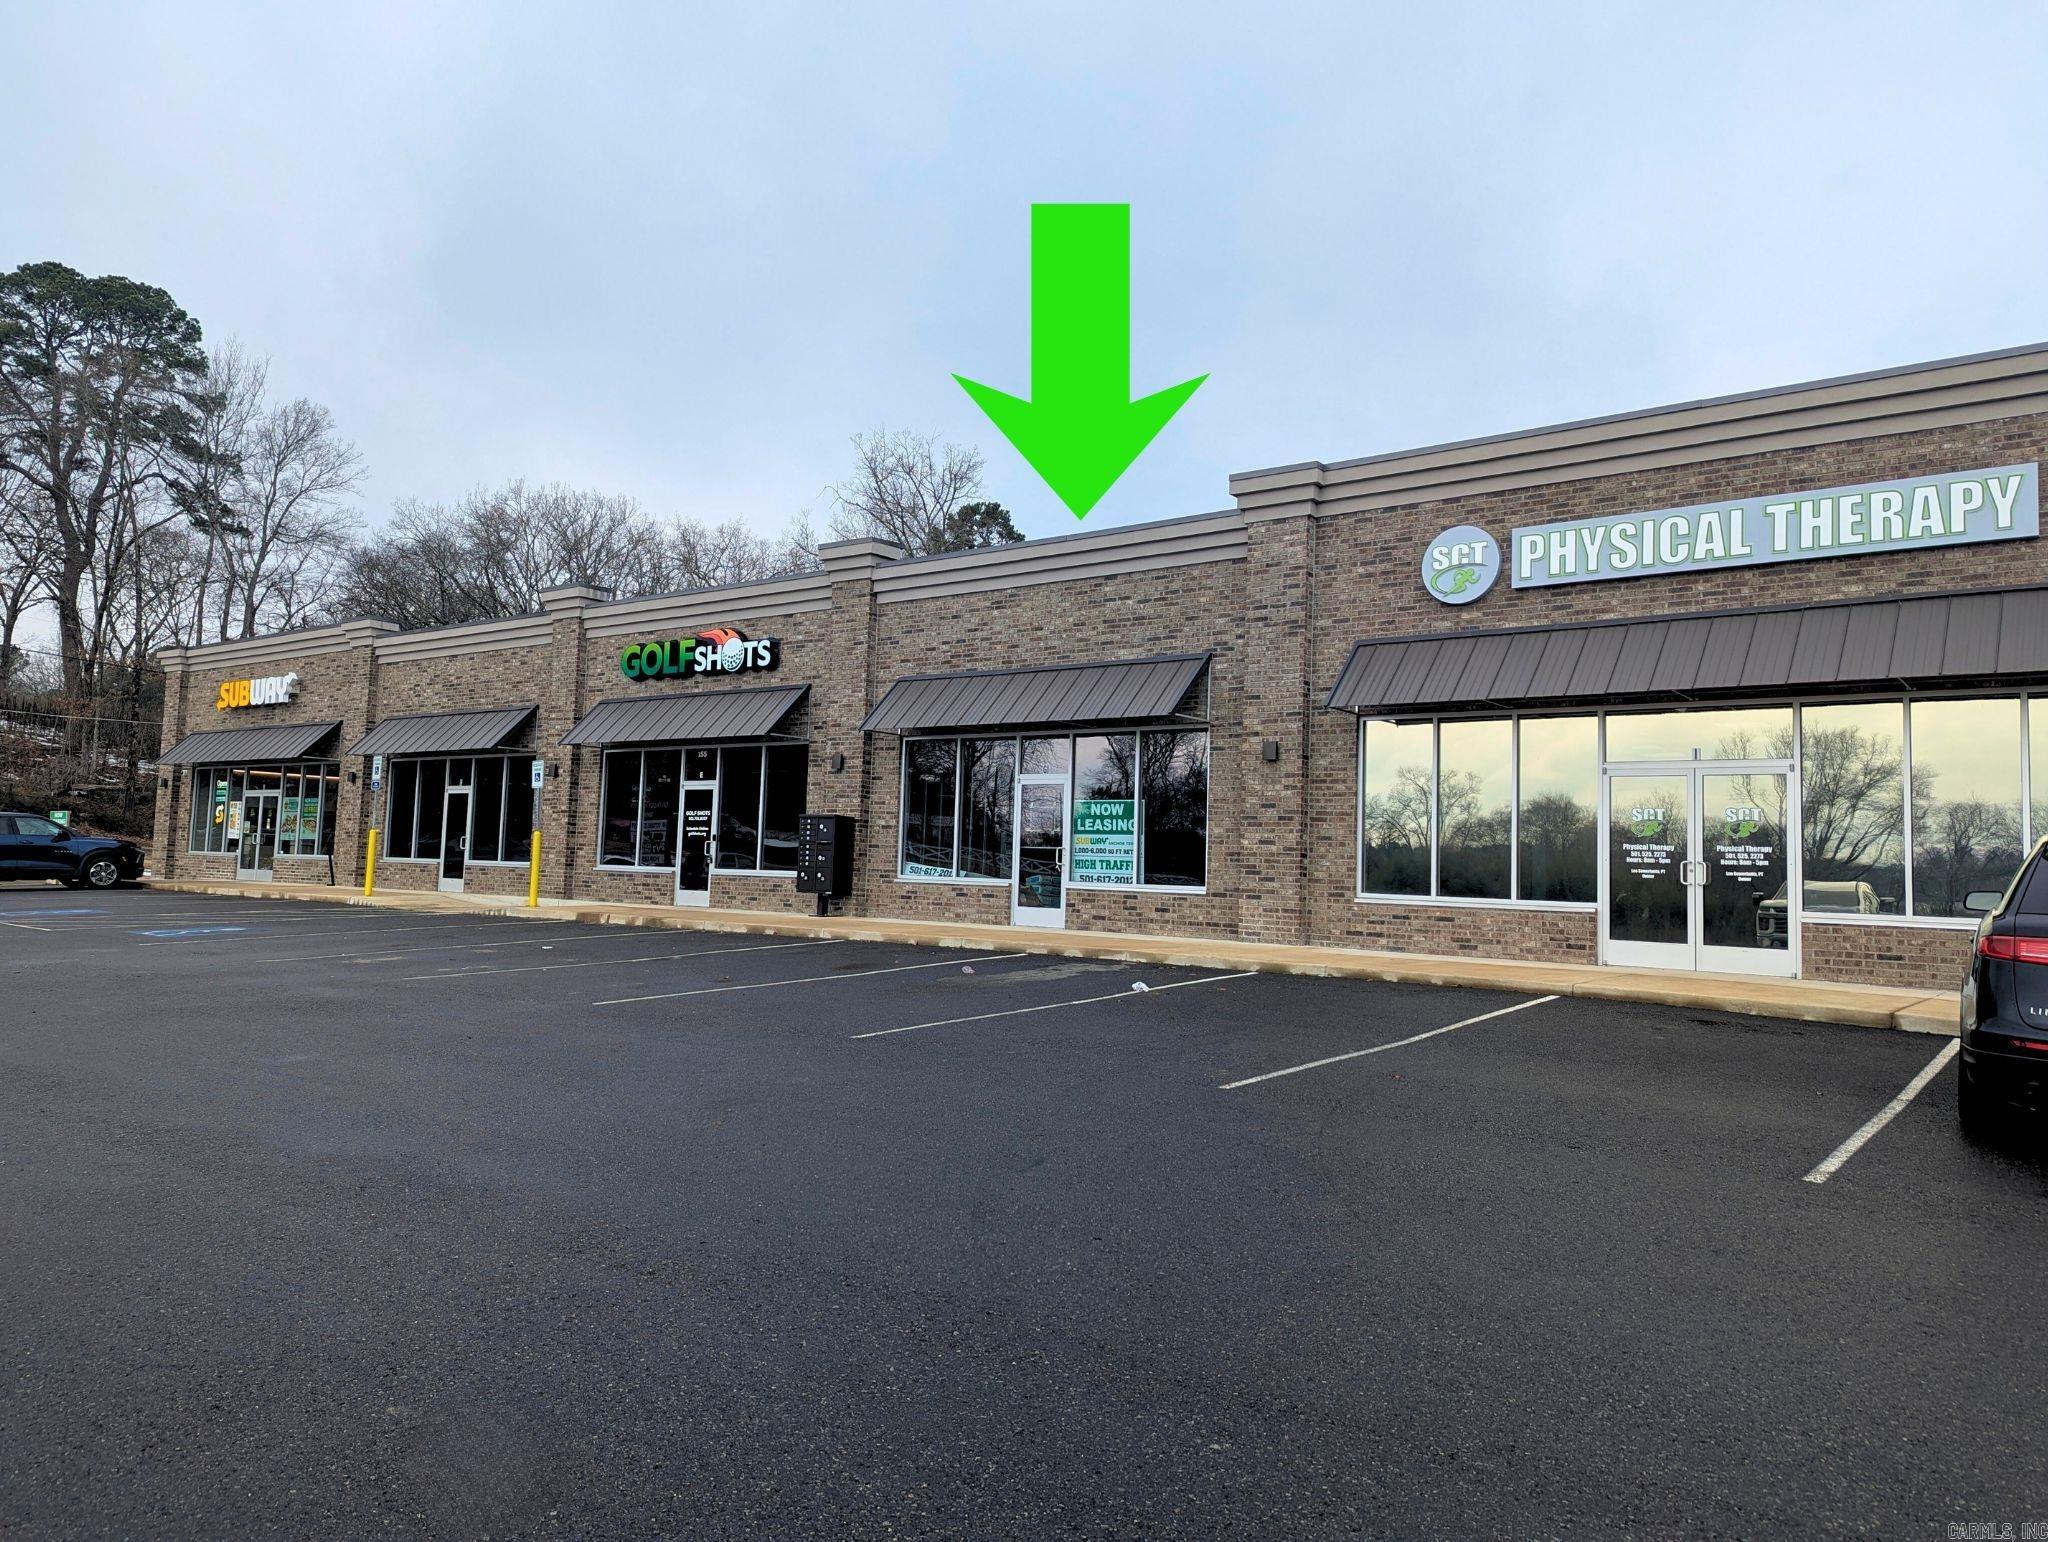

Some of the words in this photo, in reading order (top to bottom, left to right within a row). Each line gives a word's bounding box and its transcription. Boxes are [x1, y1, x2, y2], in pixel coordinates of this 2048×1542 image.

[1519, 508, 1753, 581] PHYSICAL
[1764, 474, 2024, 553] THERAPY
[1432, 541, 1488, 570] SCT
[216, 672, 298, 712] SUBWAY
[1091, 804, 1124, 816] NOW
[1726, 808, 1762, 821] SCT
[1075, 859, 1096, 870] HIGH
